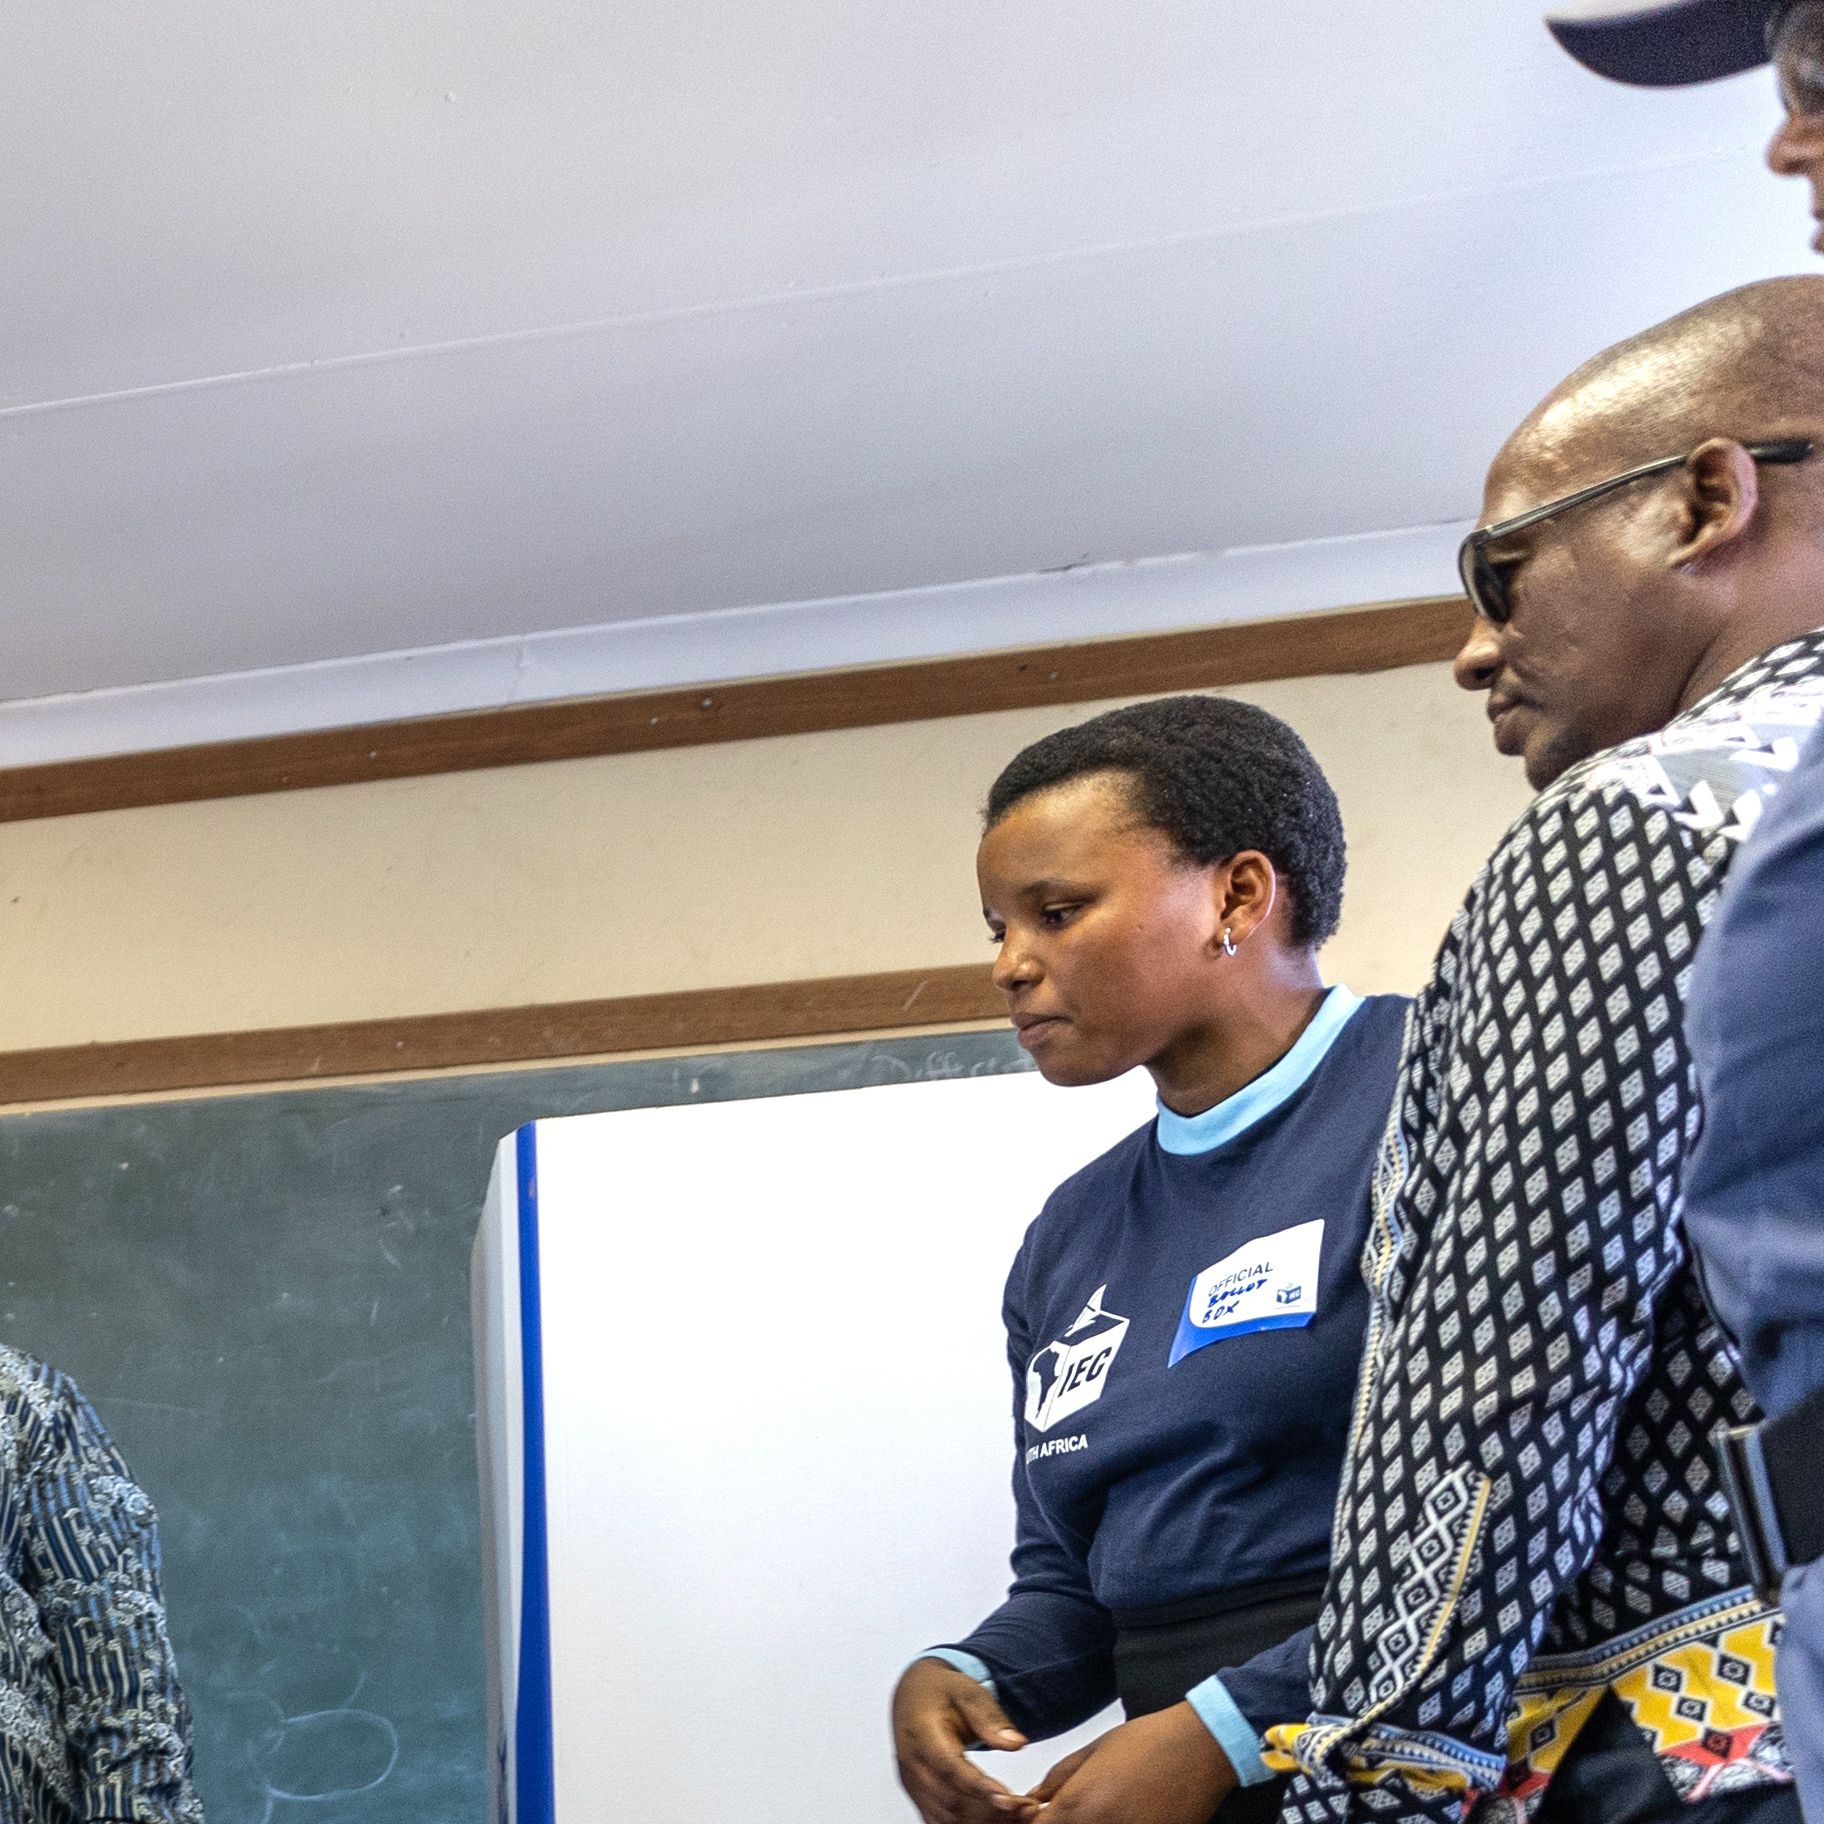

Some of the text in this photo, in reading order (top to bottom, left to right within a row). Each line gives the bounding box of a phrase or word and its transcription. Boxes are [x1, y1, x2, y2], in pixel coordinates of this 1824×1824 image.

[1209, 1262, 1273, 1297] OFFICIAL
[1057, 1346, 1112, 1398] IEC
[1040, 1434, 1089, 1458] AFRICA
